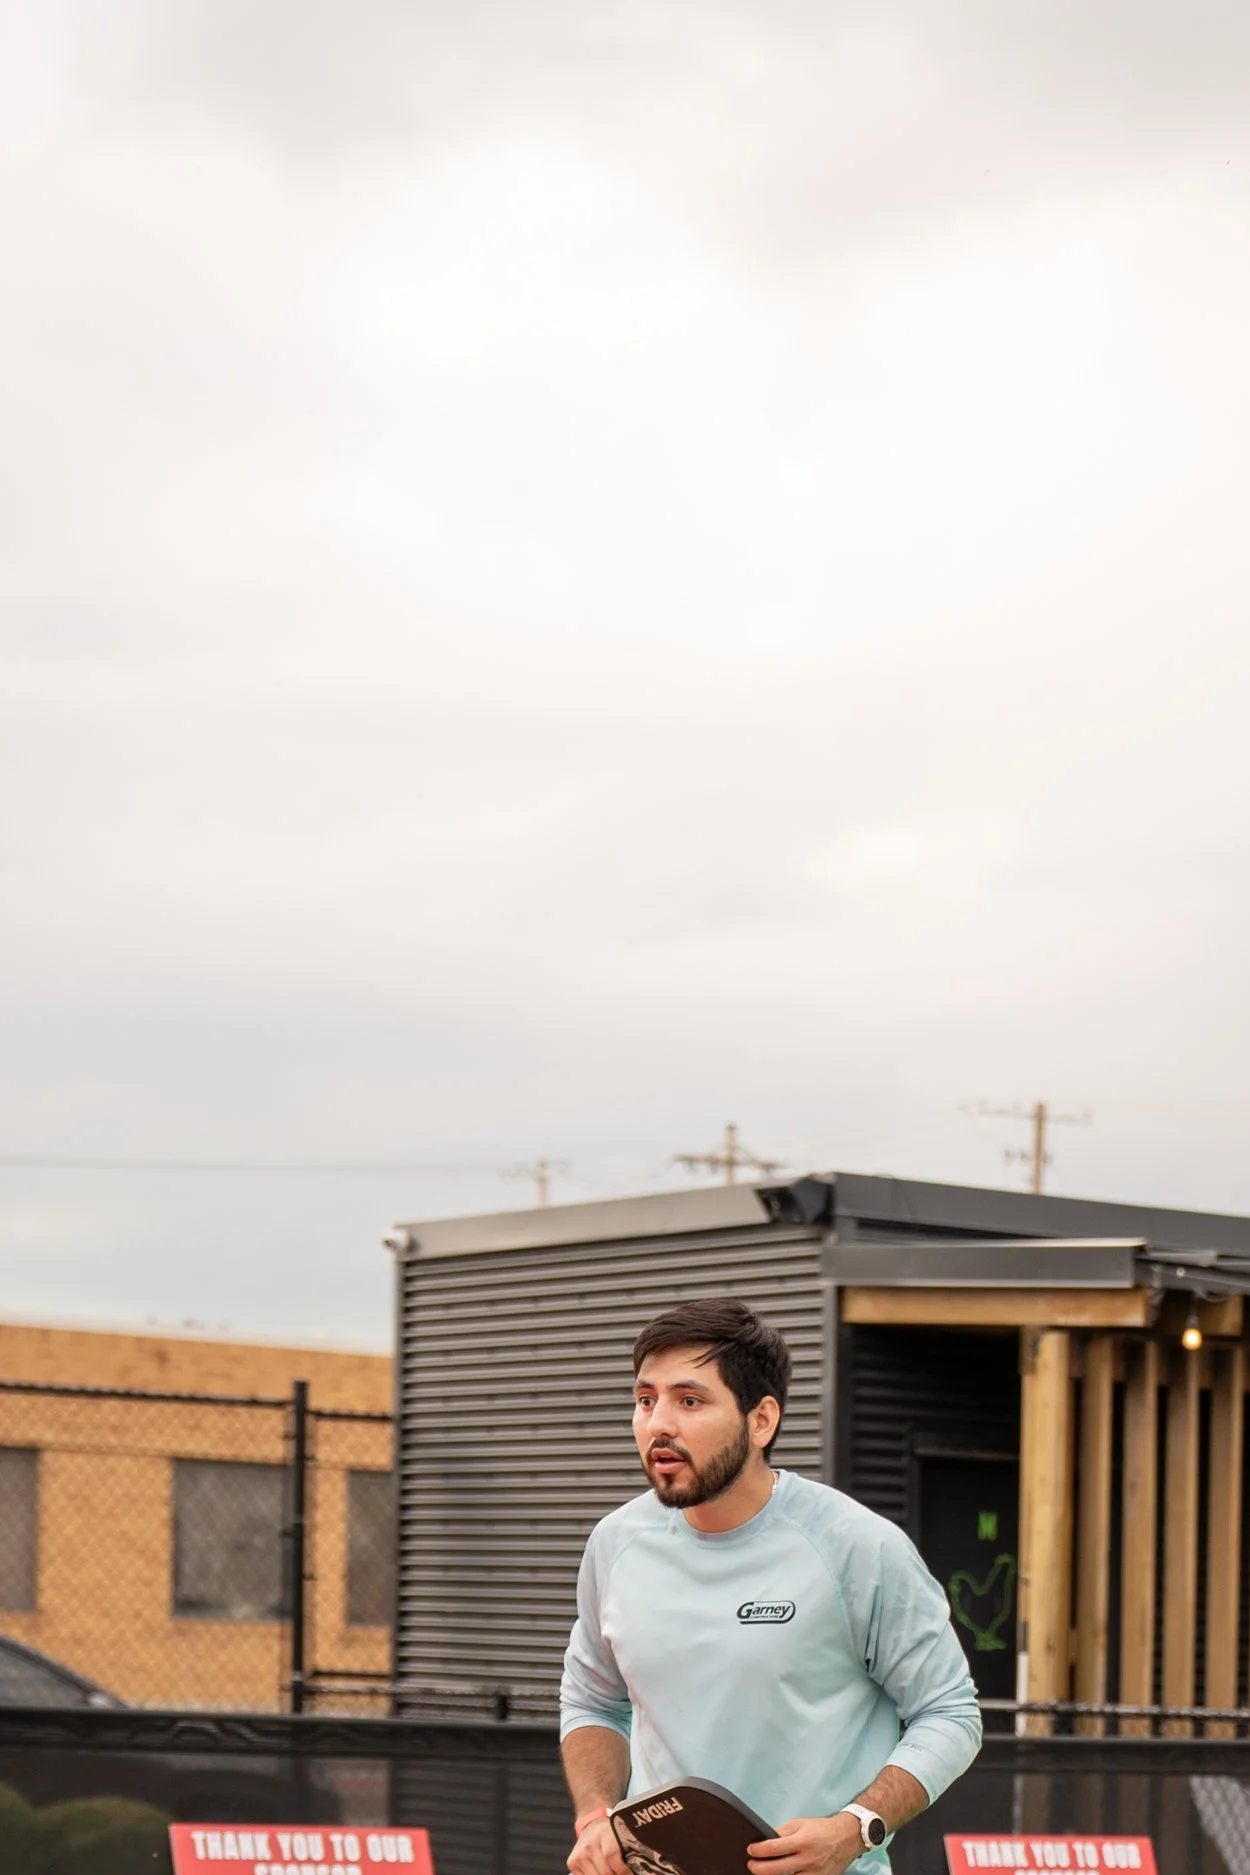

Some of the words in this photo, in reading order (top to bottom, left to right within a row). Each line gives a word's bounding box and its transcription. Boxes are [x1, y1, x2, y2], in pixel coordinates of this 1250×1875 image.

[736, 1601, 791, 1619] Garney
[632, 1796, 684, 1826] FRIDAY
[191, 1831, 272, 1860] THANK
[276, 1832, 325, 1861] YOU
[329, 1833, 361, 1862] TO
[366, 1833, 415, 1863] OUR
[962, 1840, 1029, 1868] THANK
[1030, 1840, 1071, 1868] YOU
[1072, 1841, 1099, 1869] TO
[1102, 1842, 1142, 1869] OUR
